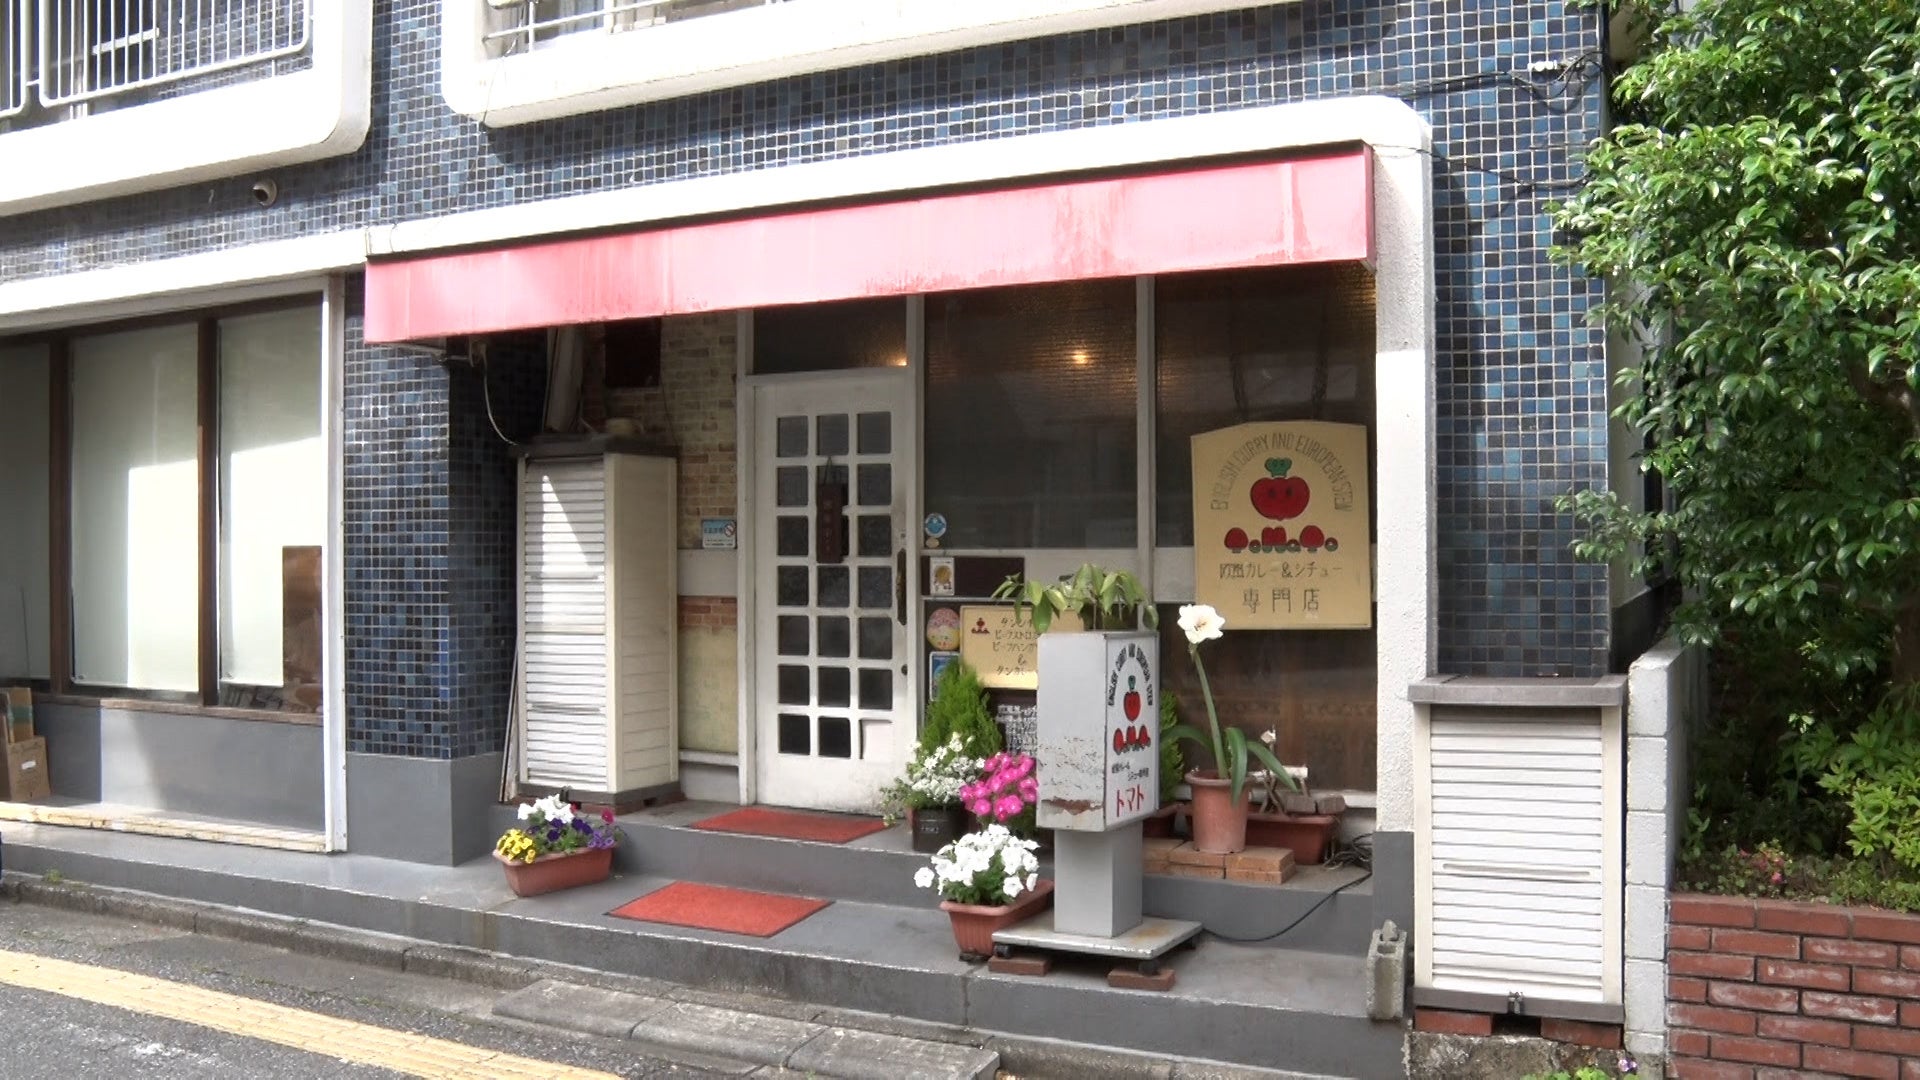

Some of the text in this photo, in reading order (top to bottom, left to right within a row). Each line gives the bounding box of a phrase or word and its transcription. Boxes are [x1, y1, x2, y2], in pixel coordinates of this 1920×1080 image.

[1271, 432, 1296, 450] AND
[1242, 587, 1321, 614] 専門店
[1116, 783, 1145, 818] トマト
